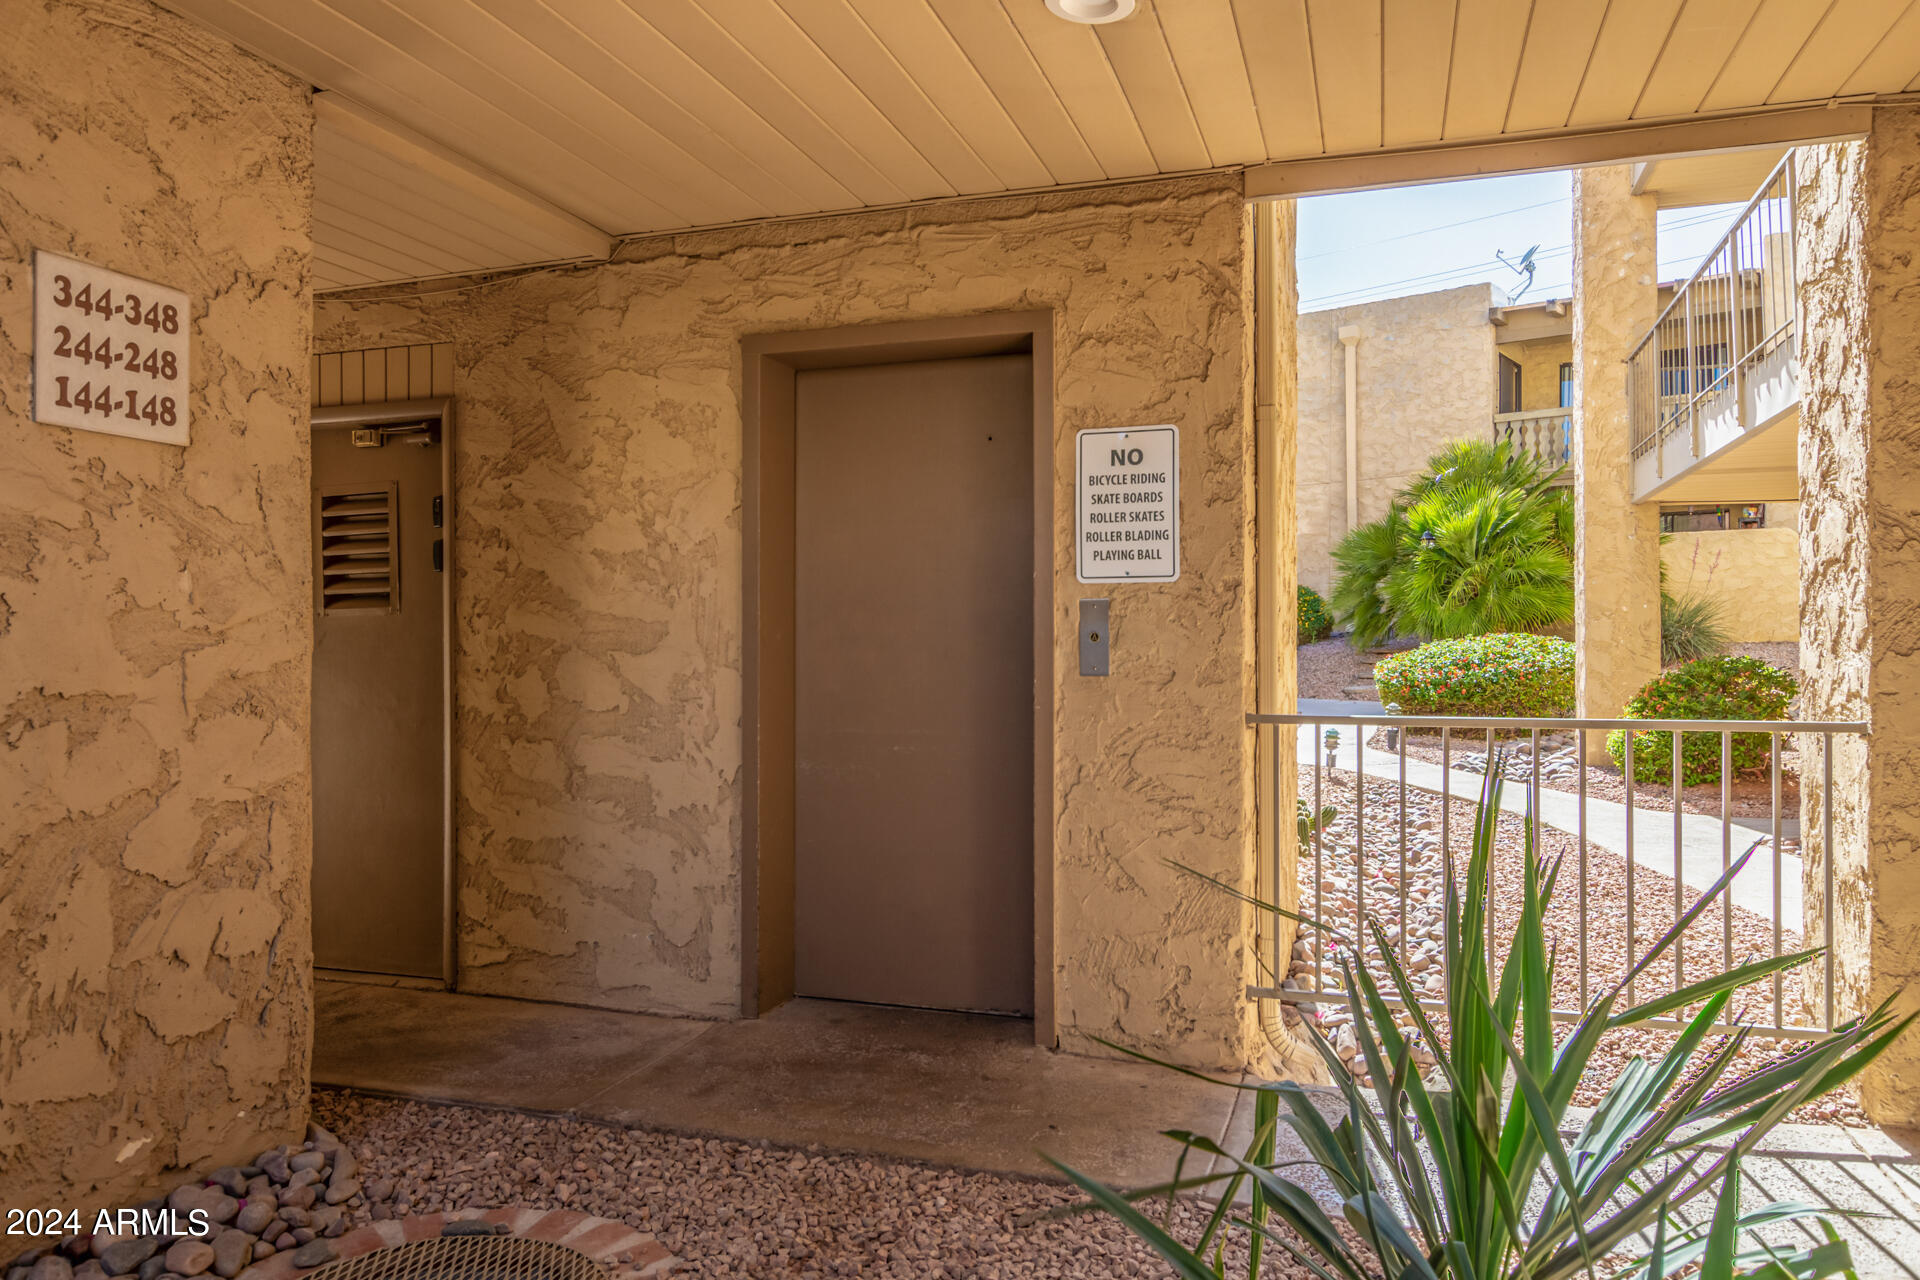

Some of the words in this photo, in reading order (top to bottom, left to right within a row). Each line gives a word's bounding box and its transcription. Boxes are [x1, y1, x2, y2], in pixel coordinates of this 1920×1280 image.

[53, 275, 179, 334] 344-348
[53, 325, 178, 380] 244-248
[55, 376, 177, 426] 144-148
[1110, 448, 1144, 467] NO
[1088, 474, 1128, 487] BICYCLE
[1130, 472, 1166, 485] RIDING
[1091, 493, 1121, 505] SKATE
[1123, 491, 1163, 504] BOARDS
[1089, 512, 1127, 523] ROLLER
[1129, 510, 1165, 522] SKATES
[1085, 531, 1123, 543] ROLLER
[1125, 529, 1169, 542] BLADING
[1093, 550, 1135, 561] PLAYING
[1137, 549, 1162, 560] BALL
